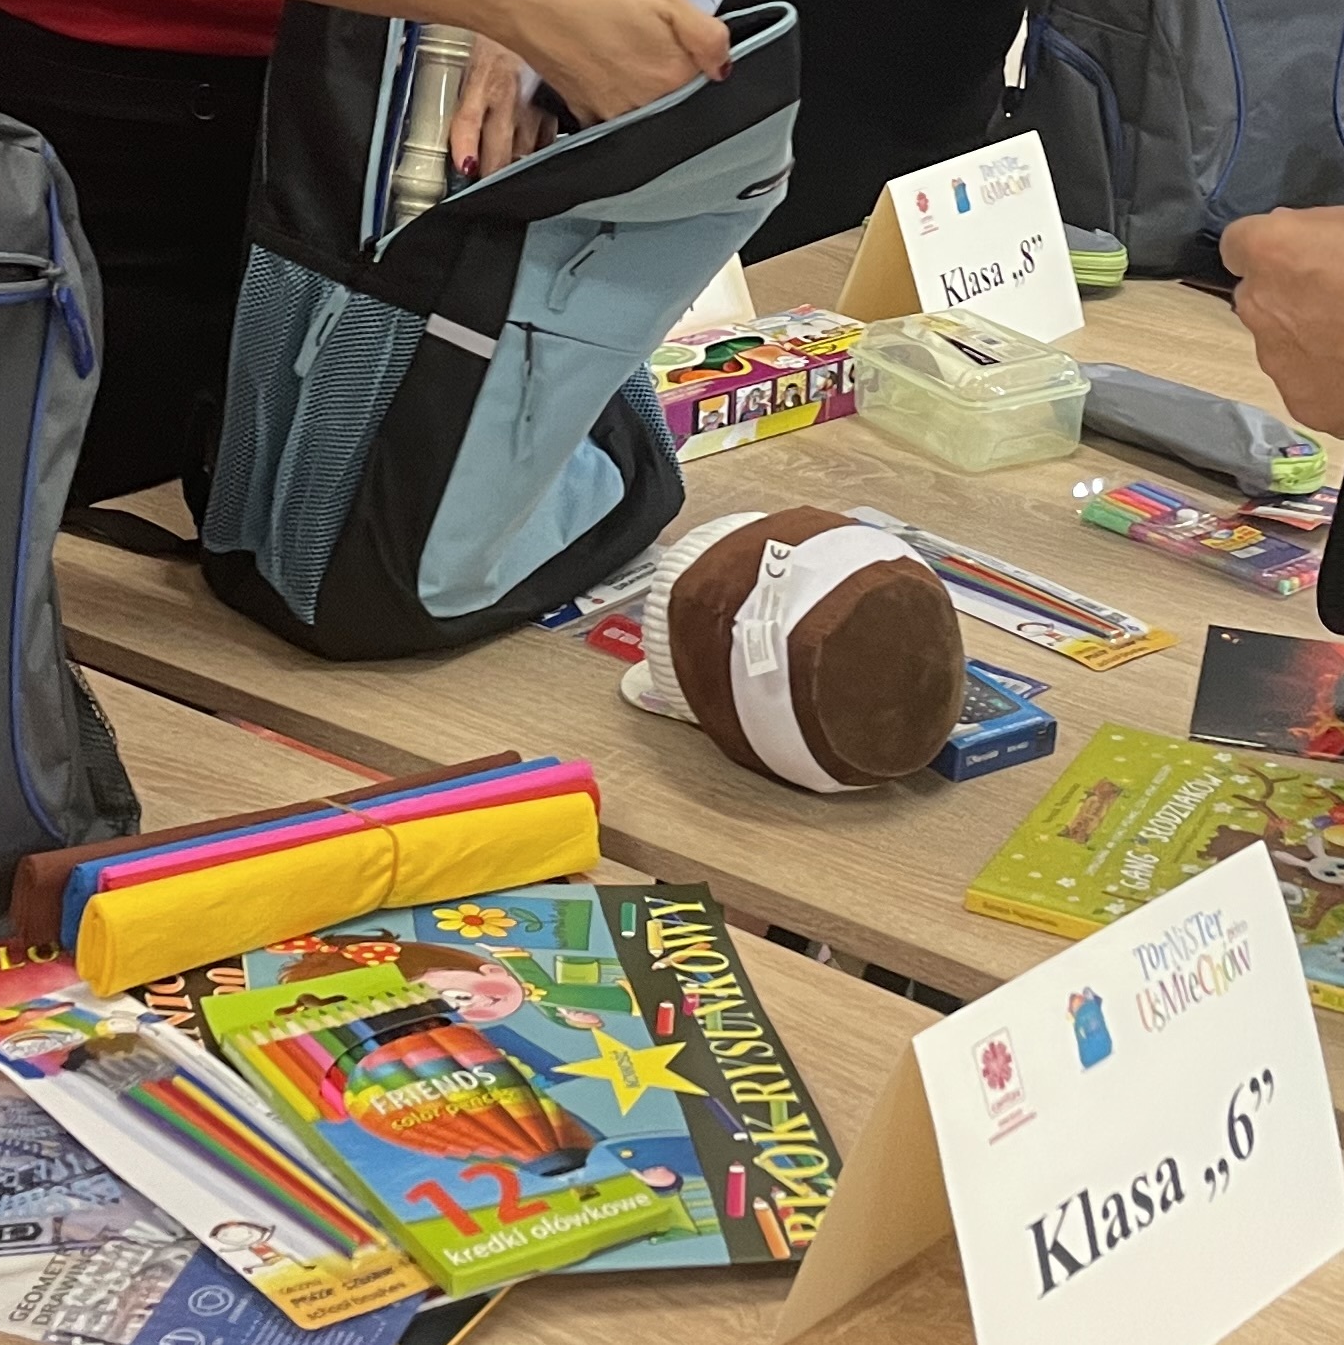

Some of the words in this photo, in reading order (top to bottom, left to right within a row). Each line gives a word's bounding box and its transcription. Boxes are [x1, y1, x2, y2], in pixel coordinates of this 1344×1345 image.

[940, 262, 1005, 308] Klasa
[765, 544, 791, 579] CE
[1119, 849, 1160, 891] GANG
[1140, 771, 1225, 843] SŁODZIAKÓW
[643, 895, 801, 1104] RYSUNKOWY
[370, 1065, 498, 1116] FRIENDS
[390, 1105, 440, 1132] color
[404, 1161, 551, 1238] 12
[743, 1112, 836, 1247] BLOK
[443, 1229, 529, 1267] kredki
[531, 1190, 654, 1241] ołówkowe
[1026, 1157, 1185, 1300] Klasa
